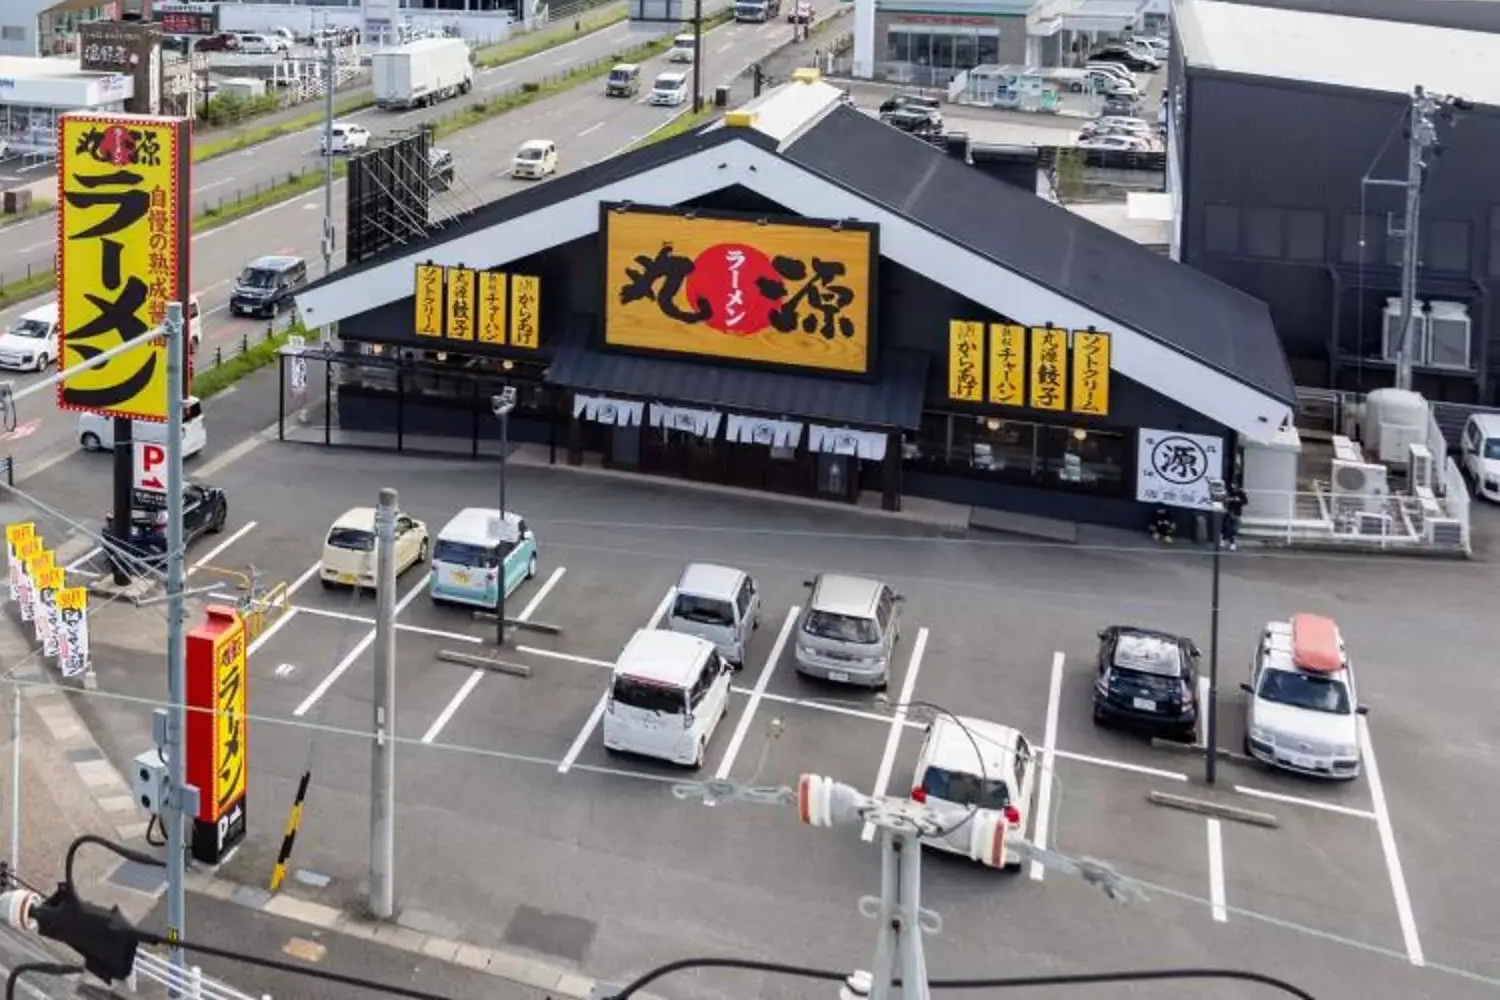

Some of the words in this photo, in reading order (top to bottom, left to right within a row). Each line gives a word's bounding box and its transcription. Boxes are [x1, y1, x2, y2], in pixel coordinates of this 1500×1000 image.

[65, 169, 157, 407] ラーメン
[725, 249, 746, 327] ラーメン
[143, 444, 165, 473] P
[1160, 443, 1198, 478] 源
[218, 665, 243, 808] ラーメン
[217, 817, 228, 850] P
